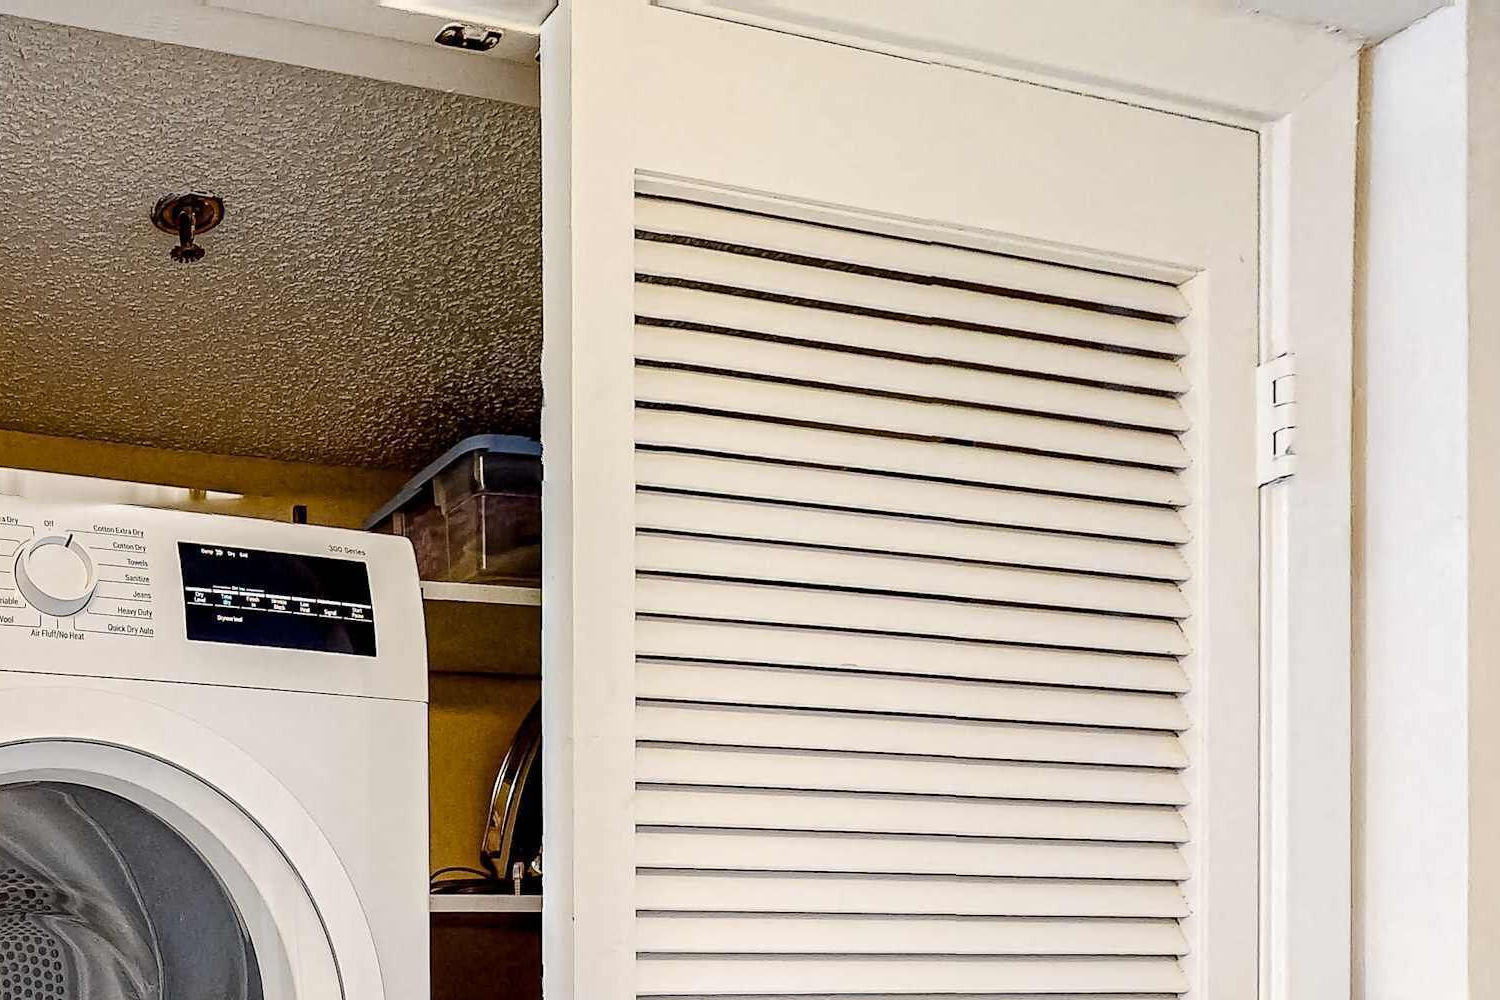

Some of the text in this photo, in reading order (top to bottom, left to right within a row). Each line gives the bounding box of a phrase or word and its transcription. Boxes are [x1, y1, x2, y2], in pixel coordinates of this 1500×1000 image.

[7, 516, 18, 524] Dry
[93, 525, 144, 537] Cotton Extra Dry
[113, 542, 146, 553] Cotton Dry
[344, 547, 366, 556] Series
[127, 559, 148, 567] Towels
[125, 574, 149, 583] Sanitize
[118, 607, 152, 617] Heavy Duty
[31, 629, 84, 640] Air Fluff/No Heat
[108, 624, 153, 635] Quick Dry Auto
